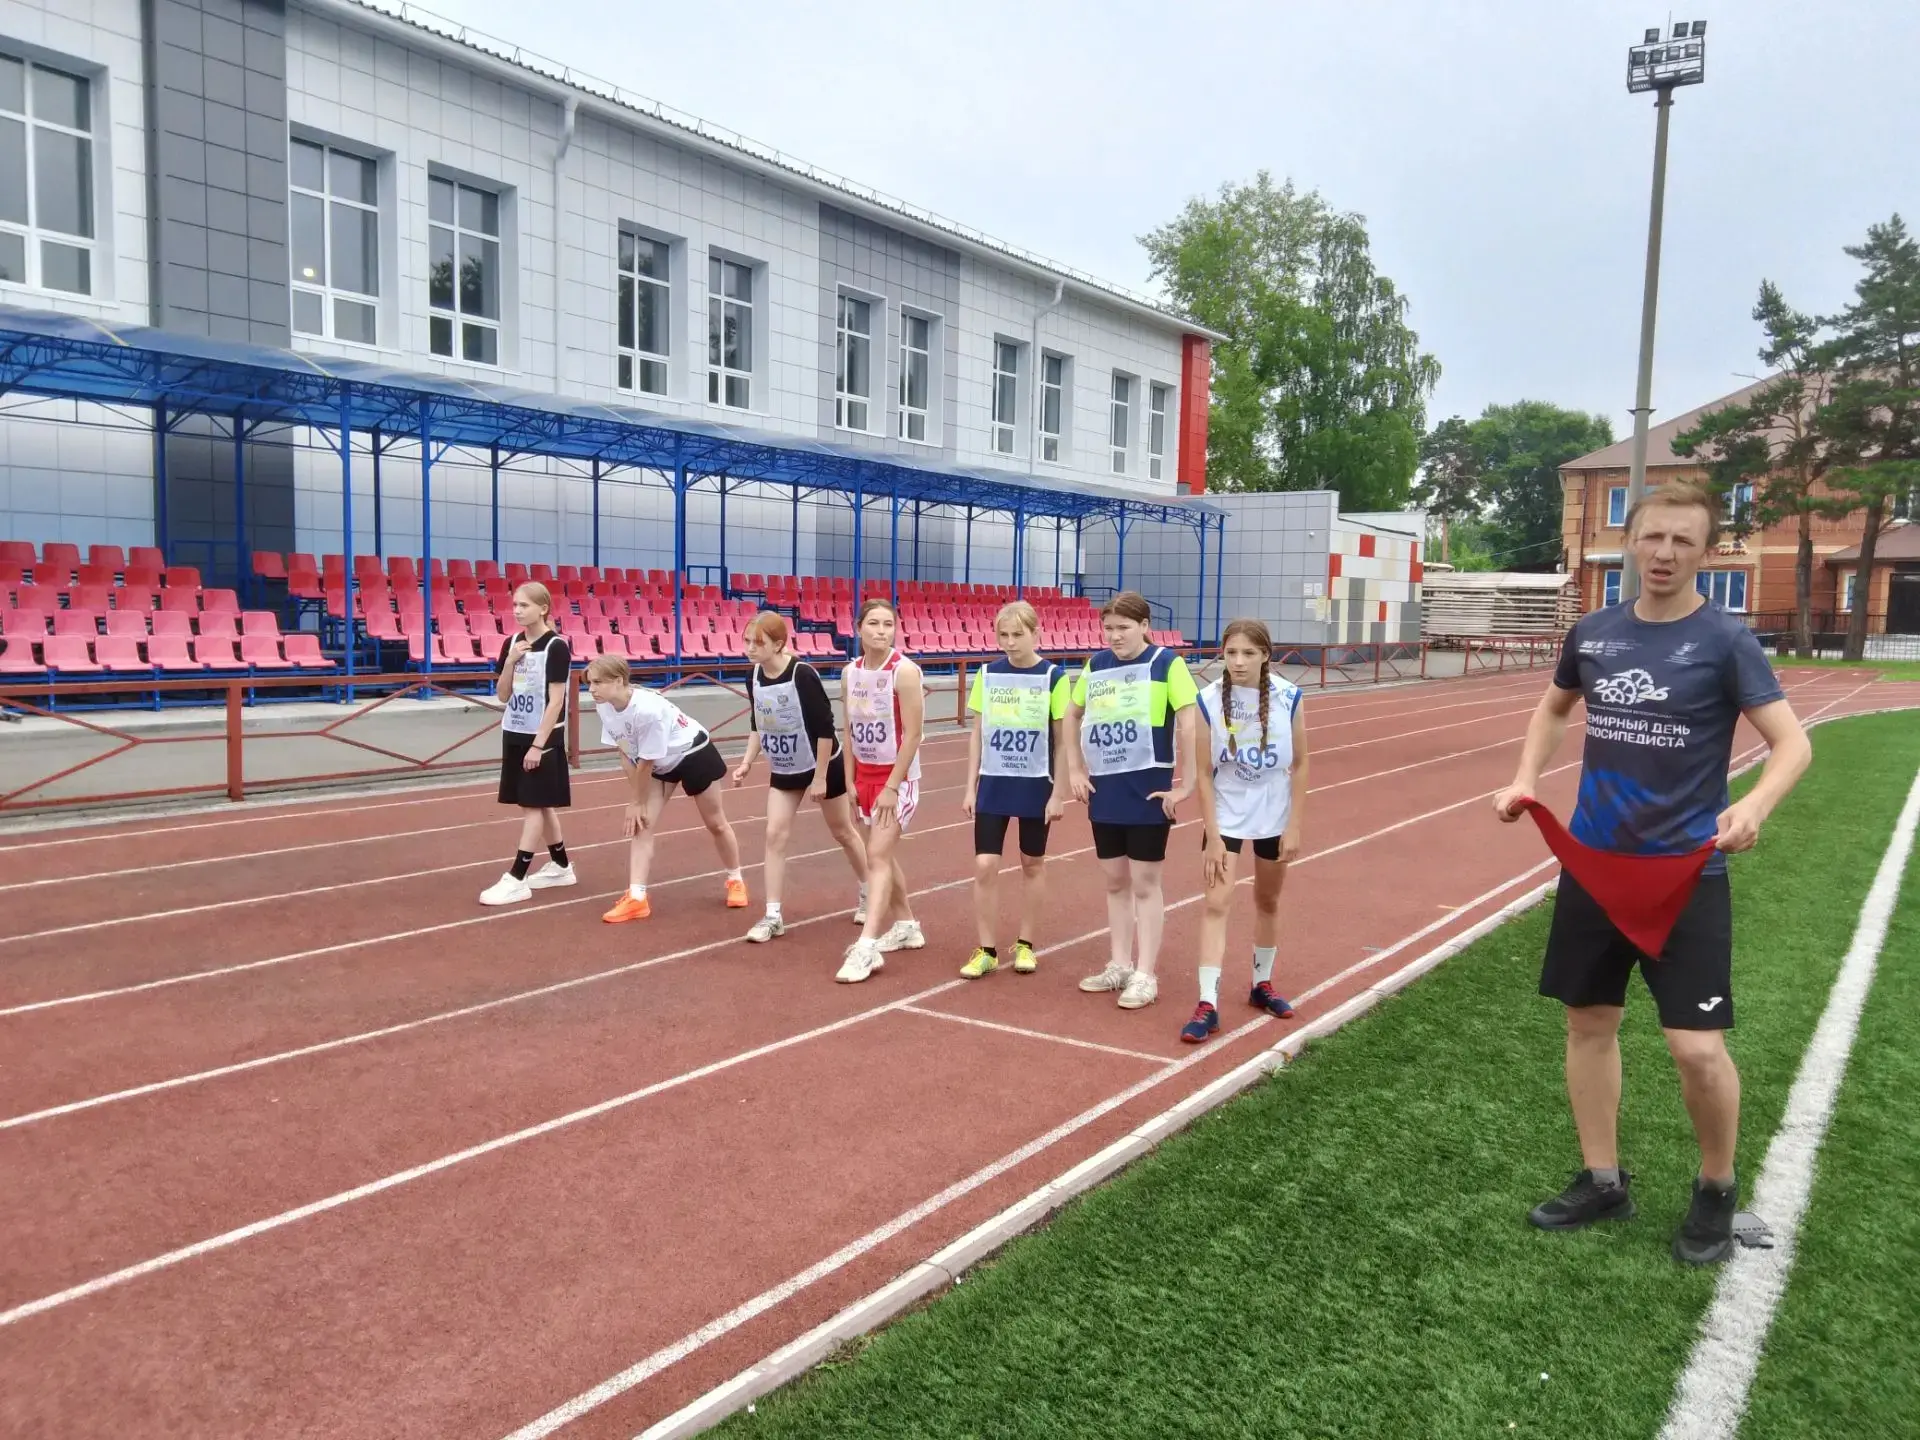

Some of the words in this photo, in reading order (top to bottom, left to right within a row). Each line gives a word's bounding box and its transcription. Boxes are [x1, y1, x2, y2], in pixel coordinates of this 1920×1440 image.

[509, 694, 534, 713] 098
[1089, 719, 1138, 747] 4338
[1587, 713, 1649, 732] ЕМИРНЫЙ
[1651, 722, 1691, 735] ДЕНЬ
[761, 733, 798, 755] 4367
[990, 729, 1041, 753] 4287
[1586, 725, 1686, 748] ЕЛОСИПЕДИСТА
